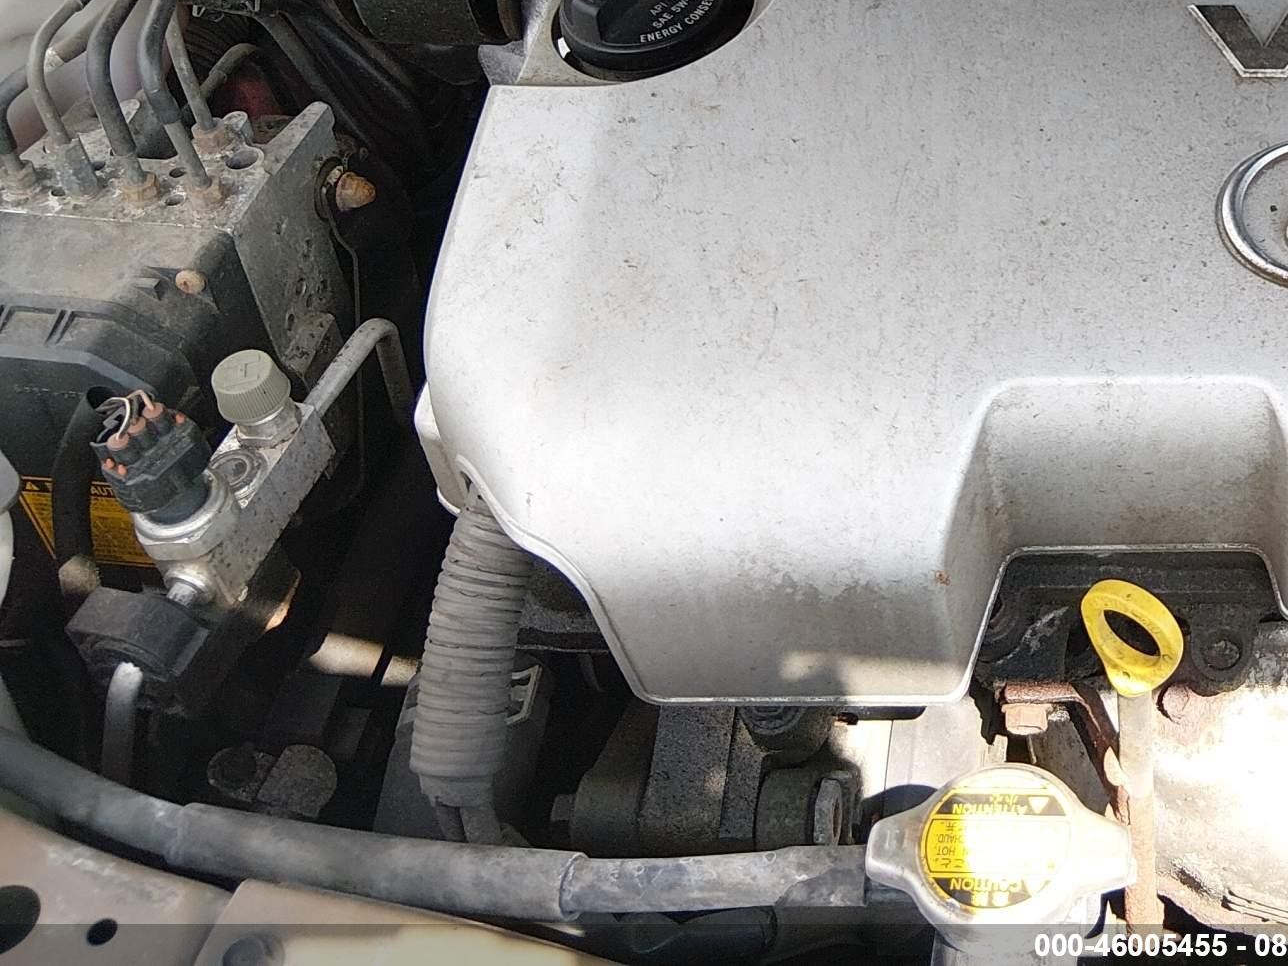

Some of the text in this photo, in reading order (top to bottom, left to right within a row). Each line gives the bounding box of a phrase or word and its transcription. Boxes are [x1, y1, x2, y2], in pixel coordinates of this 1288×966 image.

[650, 2, 669, 17] API
[652, 12, 674, 29] SAE
[639, 22, 684, 43] ENERGY
[952, 803, 1029, 816] ATTENTION
[950, 877, 1022, 892] CAUTION
